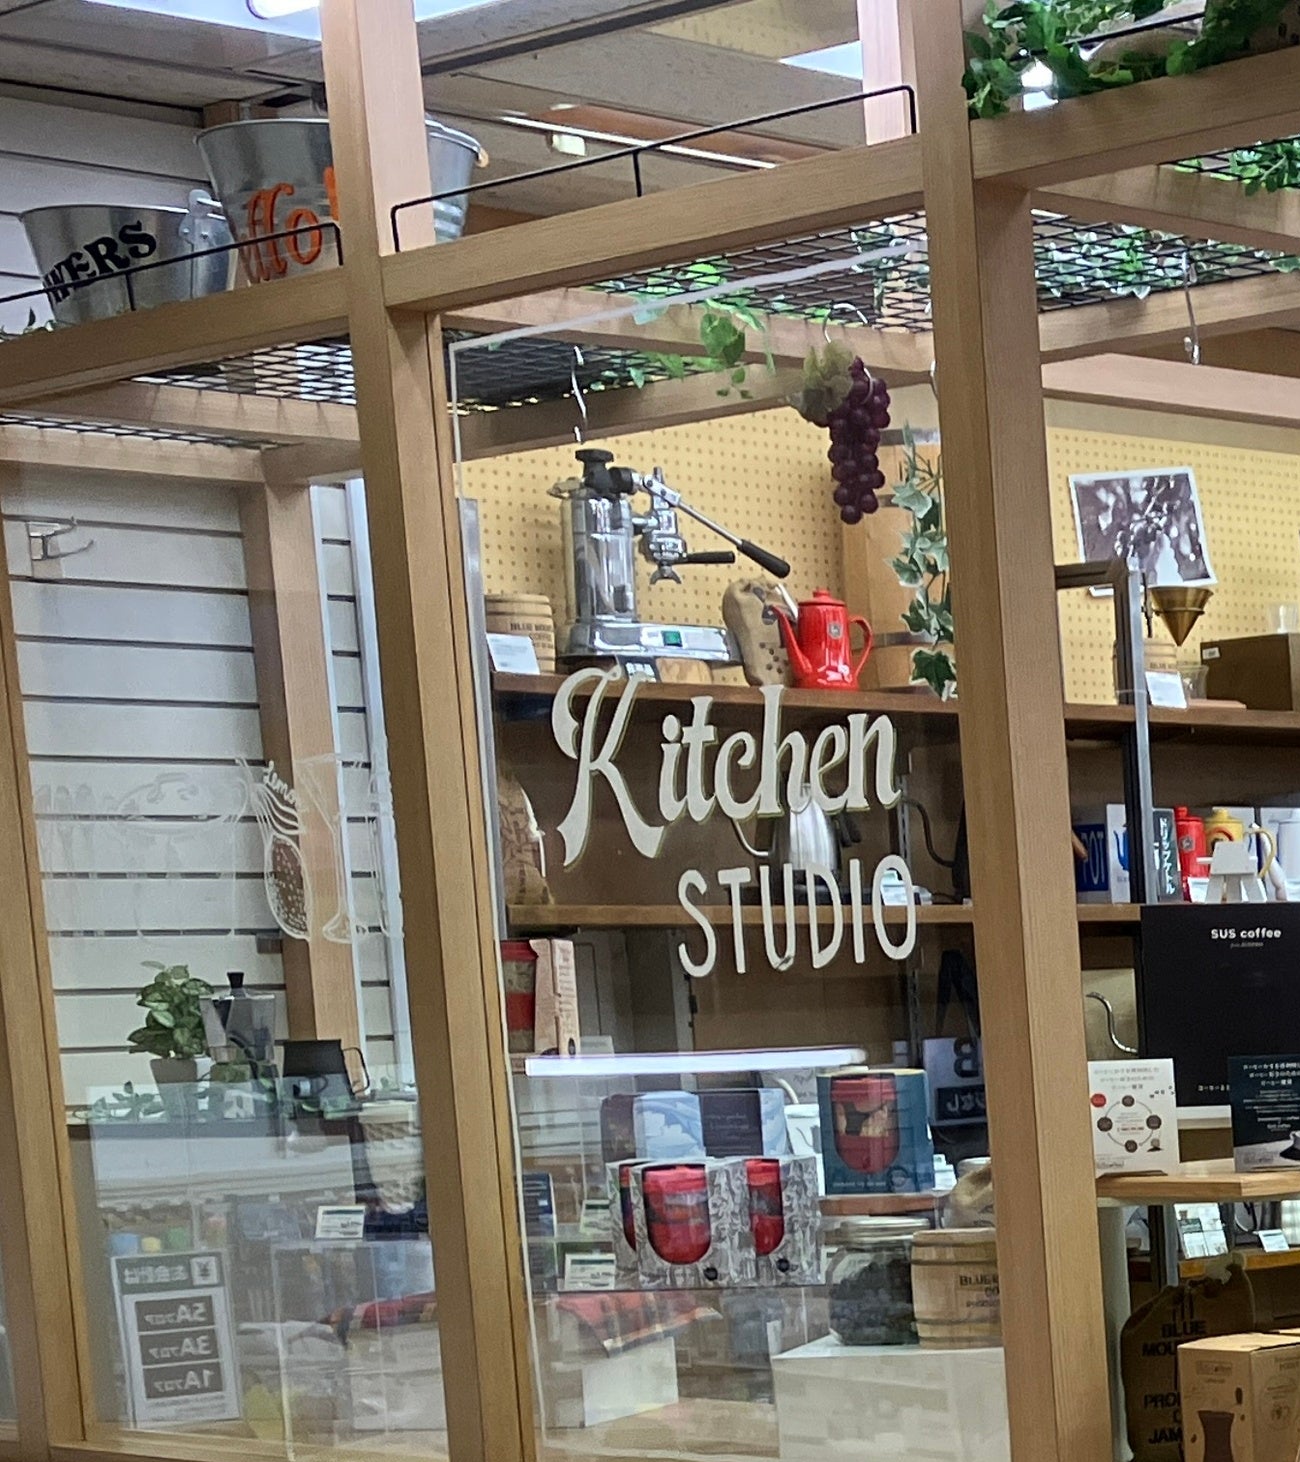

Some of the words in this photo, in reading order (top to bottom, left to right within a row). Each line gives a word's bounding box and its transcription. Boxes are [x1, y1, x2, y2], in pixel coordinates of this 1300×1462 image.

[552, 666, 902, 868] Kitchen
[678, 854, 918, 977] STUDIO
[1211, 928, 1236, 939] SUS
[1240, 927, 1281, 939] coffee
[1162, 1320, 1207, 1338] BLUE
